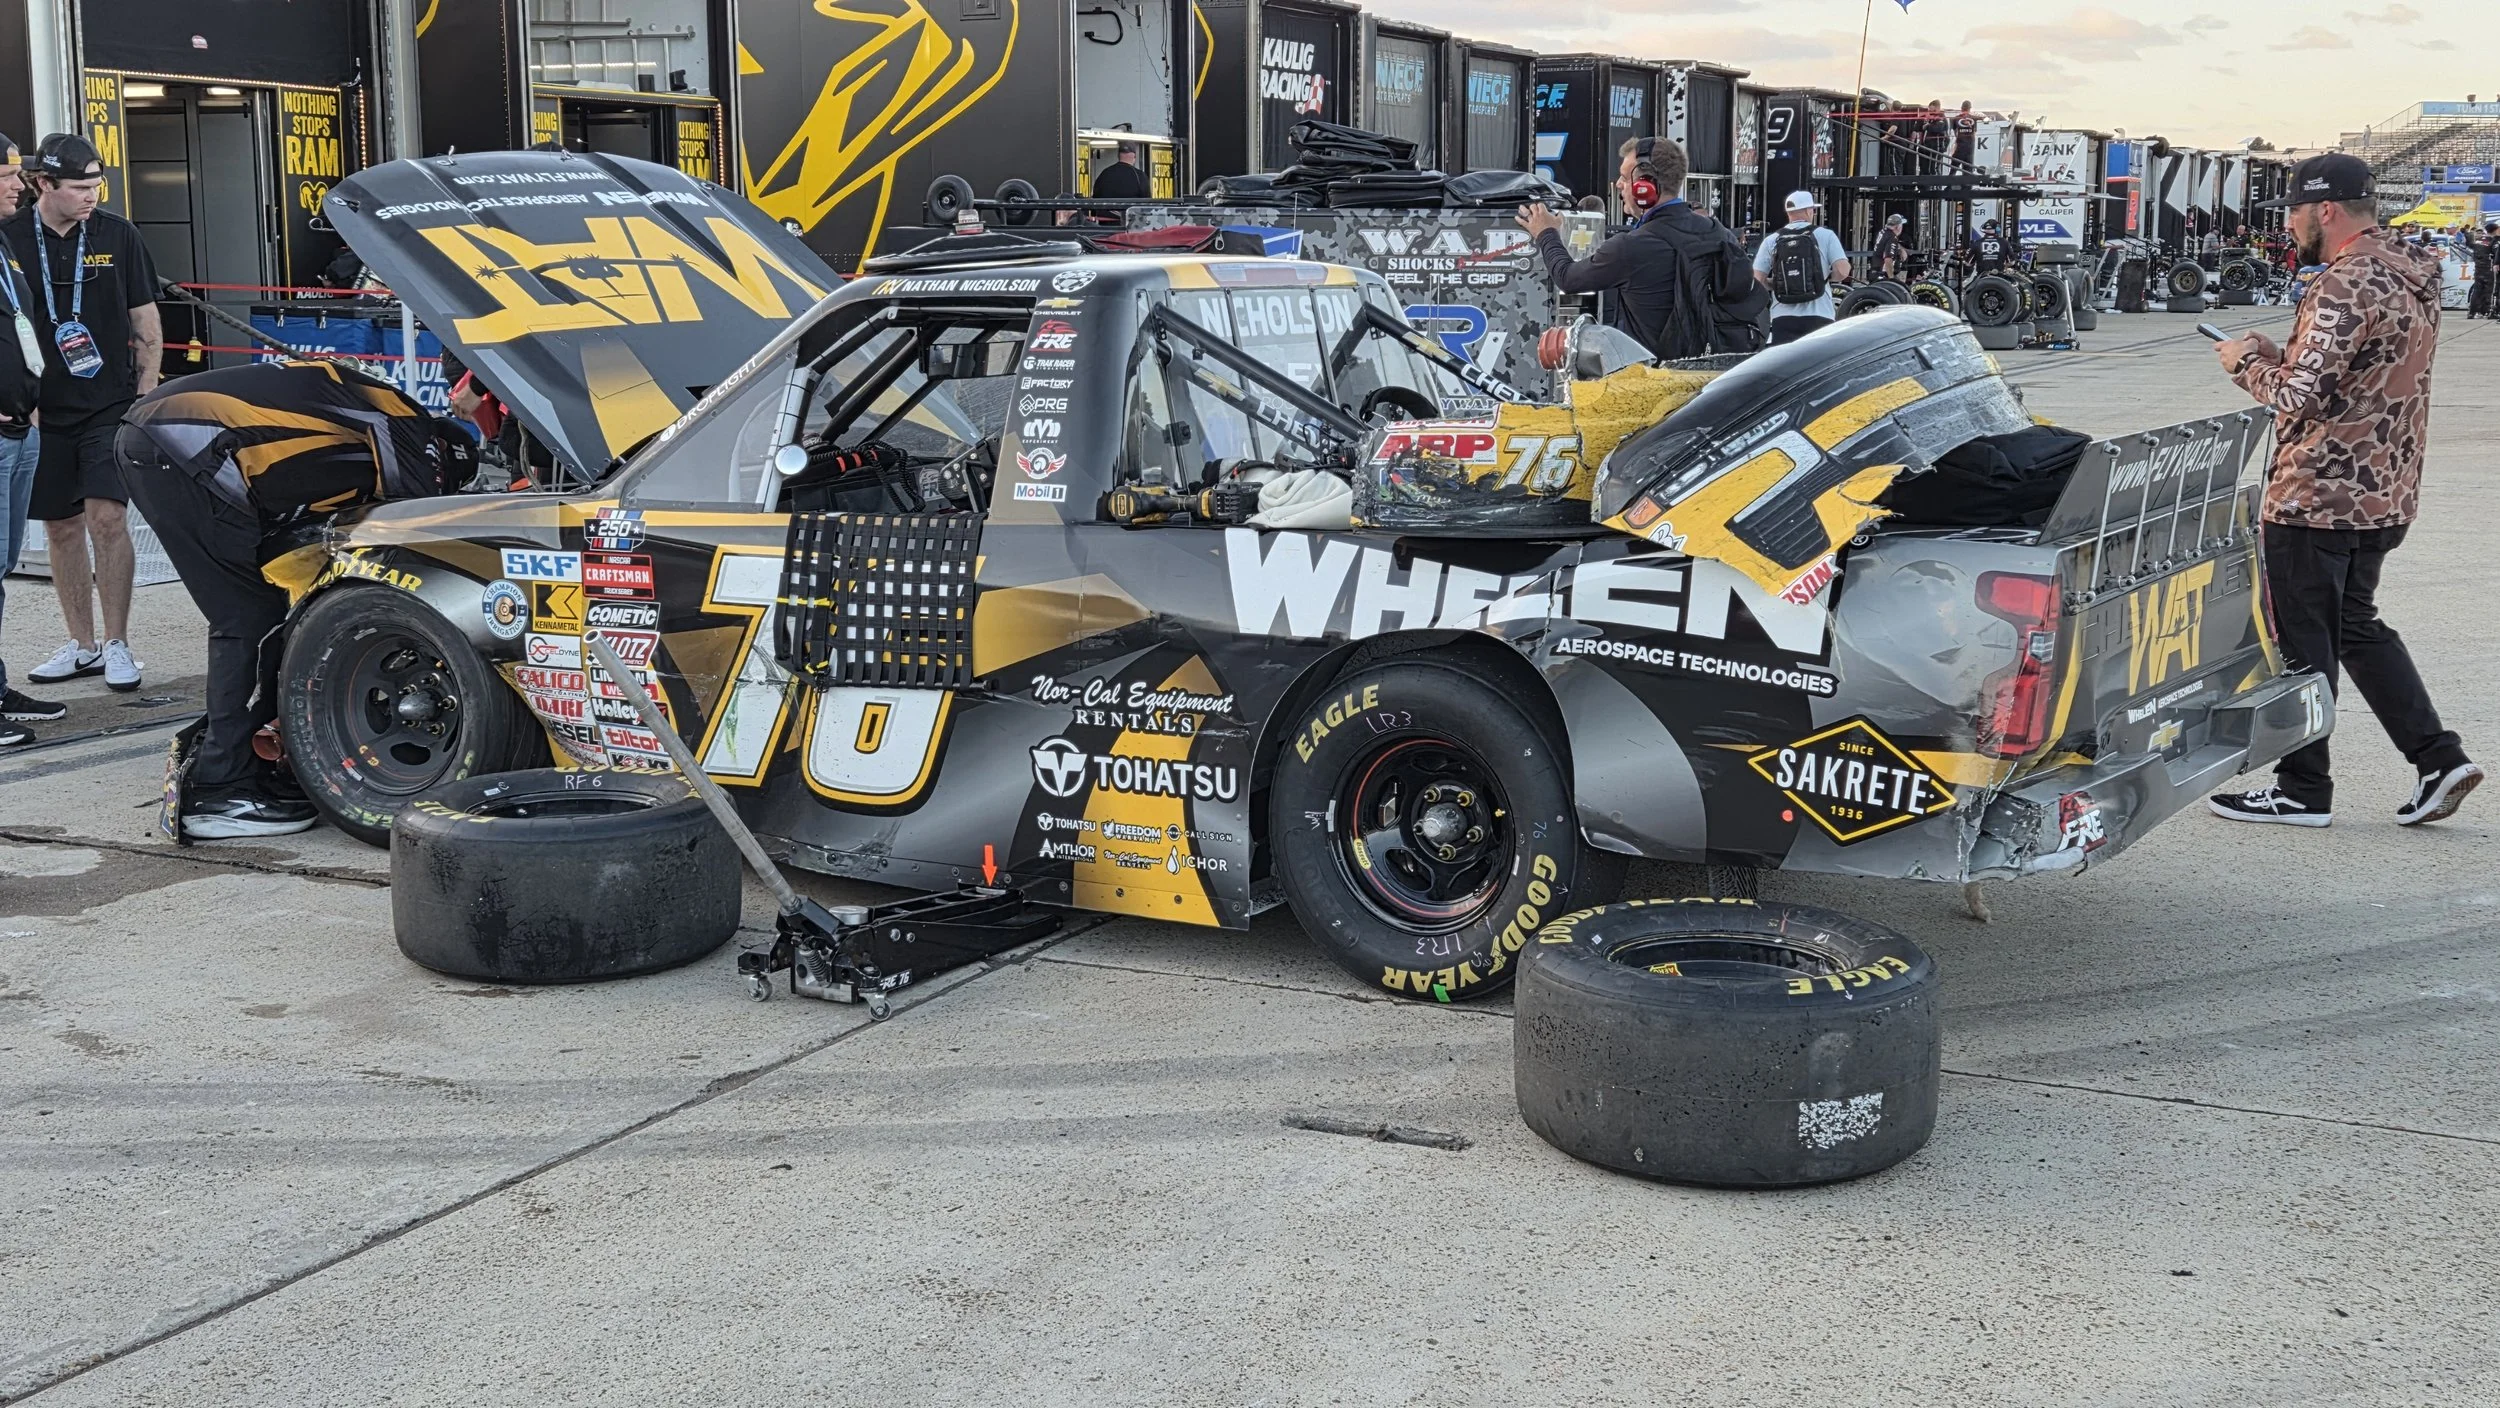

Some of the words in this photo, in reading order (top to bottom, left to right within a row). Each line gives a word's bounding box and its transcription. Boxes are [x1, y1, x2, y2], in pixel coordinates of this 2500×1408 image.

[1262, 37, 1315, 72] KAULIG
[84, 76, 116, 100] HING
[1261, 68, 1312, 102] RACING
[283, 91, 337, 116] NOTHING
[2456, 104, 2482, 113] TURN
[2483, 104, 2488, 113] 1
[292, 116, 331, 137] STOPS
[534, 112, 558, 131] HING
[679, 121, 709, 139] OTHING
[286, 136, 339, 177] RAM
[679, 141, 706, 157] STOPS
[1152, 178, 1173, 199] RAM
[375, 198, 501, 220] TECNOLOGIES
[2039, 208, 2074, 216] CALIPER
[2019, 224, 2057, 233] LYLE
[1388, 257, 1455, 270] SHOCKS
[901, 279, 957, 291] NATHAN
[959, 279, 1041, 292] NICHOLSON
[1385, 273, 1424, 284] FEEL
[1430, 273, 1462, 284] THE
[1467, 273, 1506, 284] GRIP
[1199, 294, 1354, 338] NICHOLSON
[1030, 333, 1078, 349] FRE
[1055, 360, 1075, 368] RACER
[677, 355, 757, 429] DROPLIGHT
[1035, 398, 1068, 410] PRG
[1375, 434, 1495, 459] ARP
[1495, 435, 1579, 492] 76
[1016, 485, 1050, 498] Mobil
[598, 520, 631, 537] 250
[507, 553, 577, 577] SKF
[609, 557, 631, 565] NASCAR
[586, 568, 650, 583] CRAFTSMAN
[486, 583, 523, 601] CHAMPION
[588, 607, 657, 625] COMETIC
[487, 617, 523, 636] IRRIGATION
[535, 621, 579, 632] KENNAMETAL
[2129, 560, 2215, 697] WAT
[606, 636, 652, 658] LOTZ
[1557, 637, 1674, 668] AEROSPACE
[1679, 653, 1834, 694] TECHNOLOGIES
[517, 670, 584, 690] CALICO
[593, 668, 646, 685] LINN
[1032, 675, 1120, 708] Nor-Cal
[1128, 682, 1233, 713] Equipment
[2128, 698, 2157, 724] WHELEN
[2178, 680, 2204, 700] TECHNOLOGIES
[594, 698, 640, 725] Holley
[2300, 682, 2325, 739] 76
[1076, 710, 1193, 733] RENTALS
[1295, 684, 1379, 763] EAGLE
[1839, 741, 1874, 756] SINCE
[565, 775, 586, 789] RF
[592, 775, 602, 787] 6
[1094, 756, 1236, 799] TOHATSU
[1776, 748, 1930, 815] SAKRETE
[1831, 805, 1863, 820] 1936
[1055, 818, 1096, 832] TOHATSU
[1116, 824, 1161, 839] FREEDOM
[2057, 809, 2105, 852] FRE
[1116, 834, 1161, 844] WARRANTY
[1184, 830, 1208, 840] CALL
[1209, 832, 1232, 842] SIGN
[1038, 838, 1096, 859] AMTHOR
[1104, 850, 1132, 861] Nor-Cal
[1132, 853, 1162, 864] Equipment
[1056, 855, 1096, 863] INTERNATIONAL
[1116, 861, 1151, 870] RENTALS
[1182, 855, 1228, 872] ICHOR
[1787, 955, 1911, 995] EAGLE
